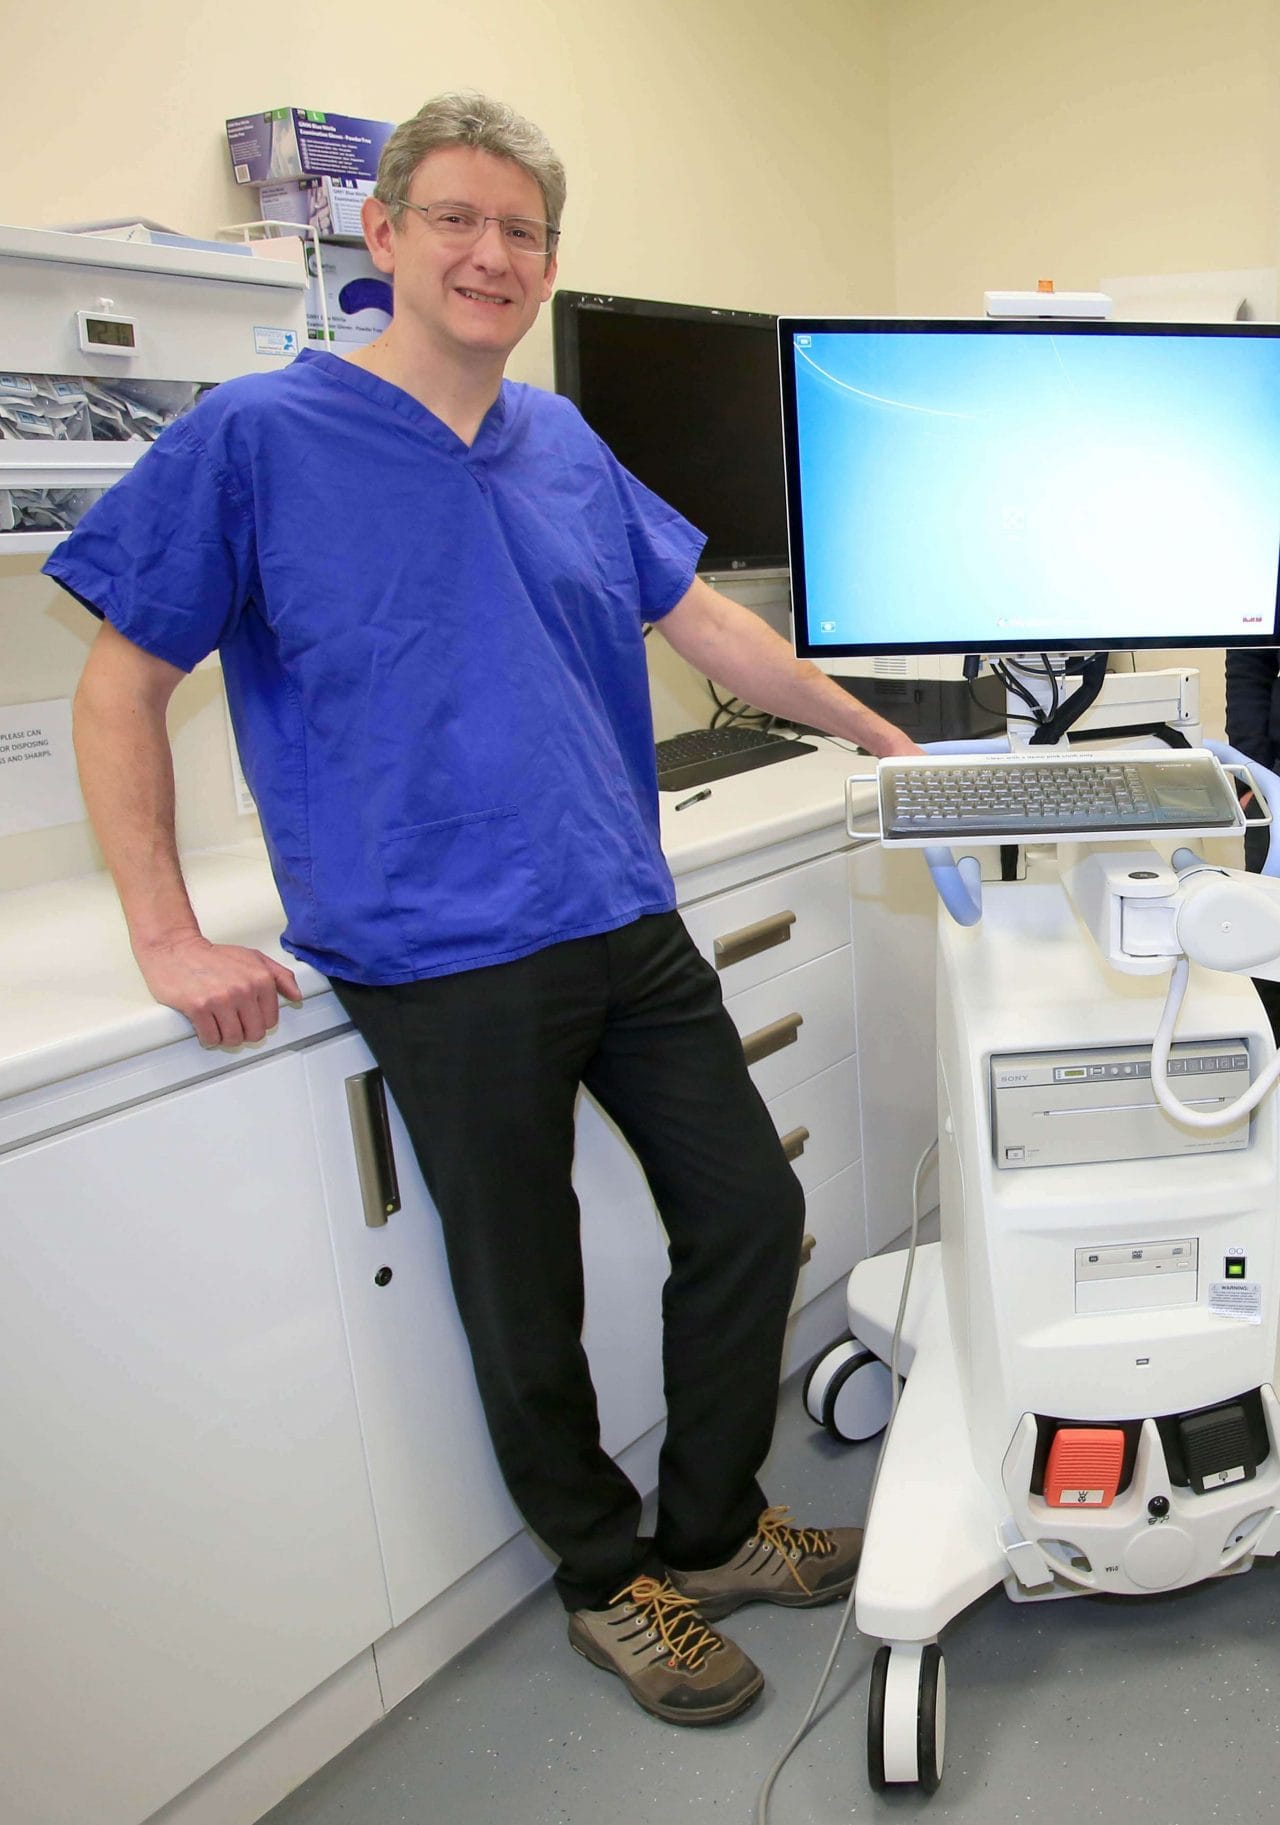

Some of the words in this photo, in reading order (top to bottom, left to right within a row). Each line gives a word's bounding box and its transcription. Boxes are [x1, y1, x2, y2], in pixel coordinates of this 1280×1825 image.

[1, 731, 25, 740] PLEASE
[27, 729, 42, 737] CAN
[12, 739, 49, 751] DISPOSING
[8, 754, 23, 763] AND
